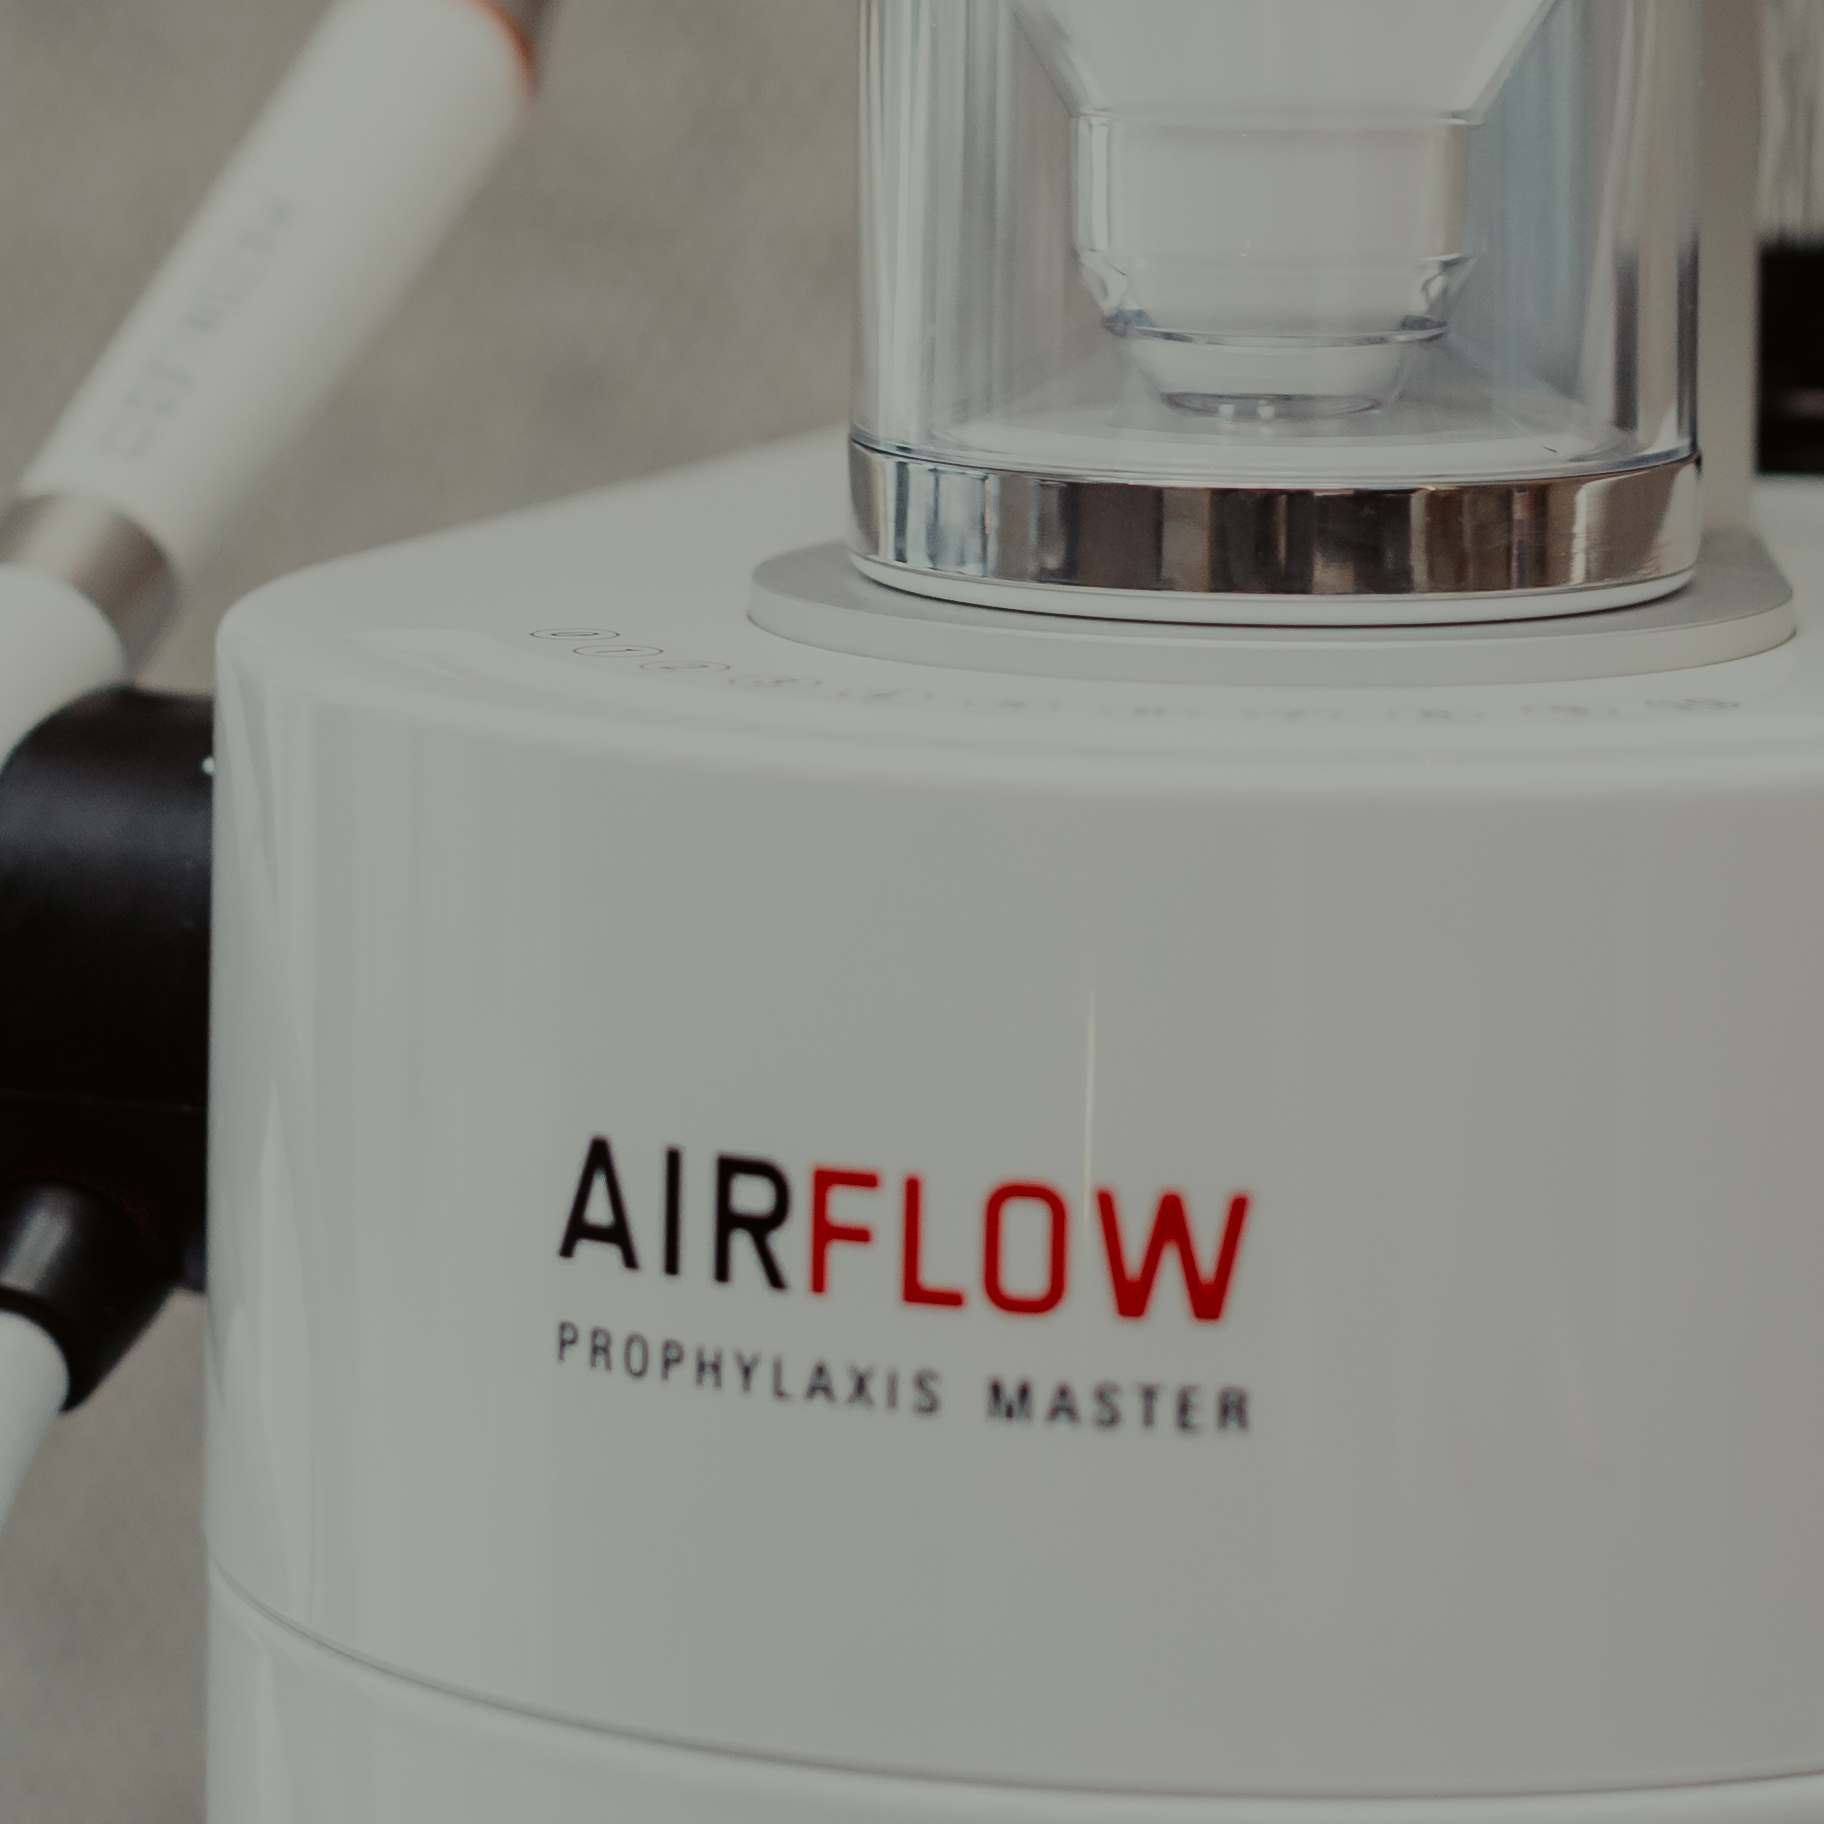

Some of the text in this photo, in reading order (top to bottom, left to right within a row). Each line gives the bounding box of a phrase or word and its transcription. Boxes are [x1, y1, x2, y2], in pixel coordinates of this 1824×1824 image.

[558, 1136, 1251, 1321] AIRFLOW
[557, 1321, 1250, 1433] PROPHYLAXIS MASTER
